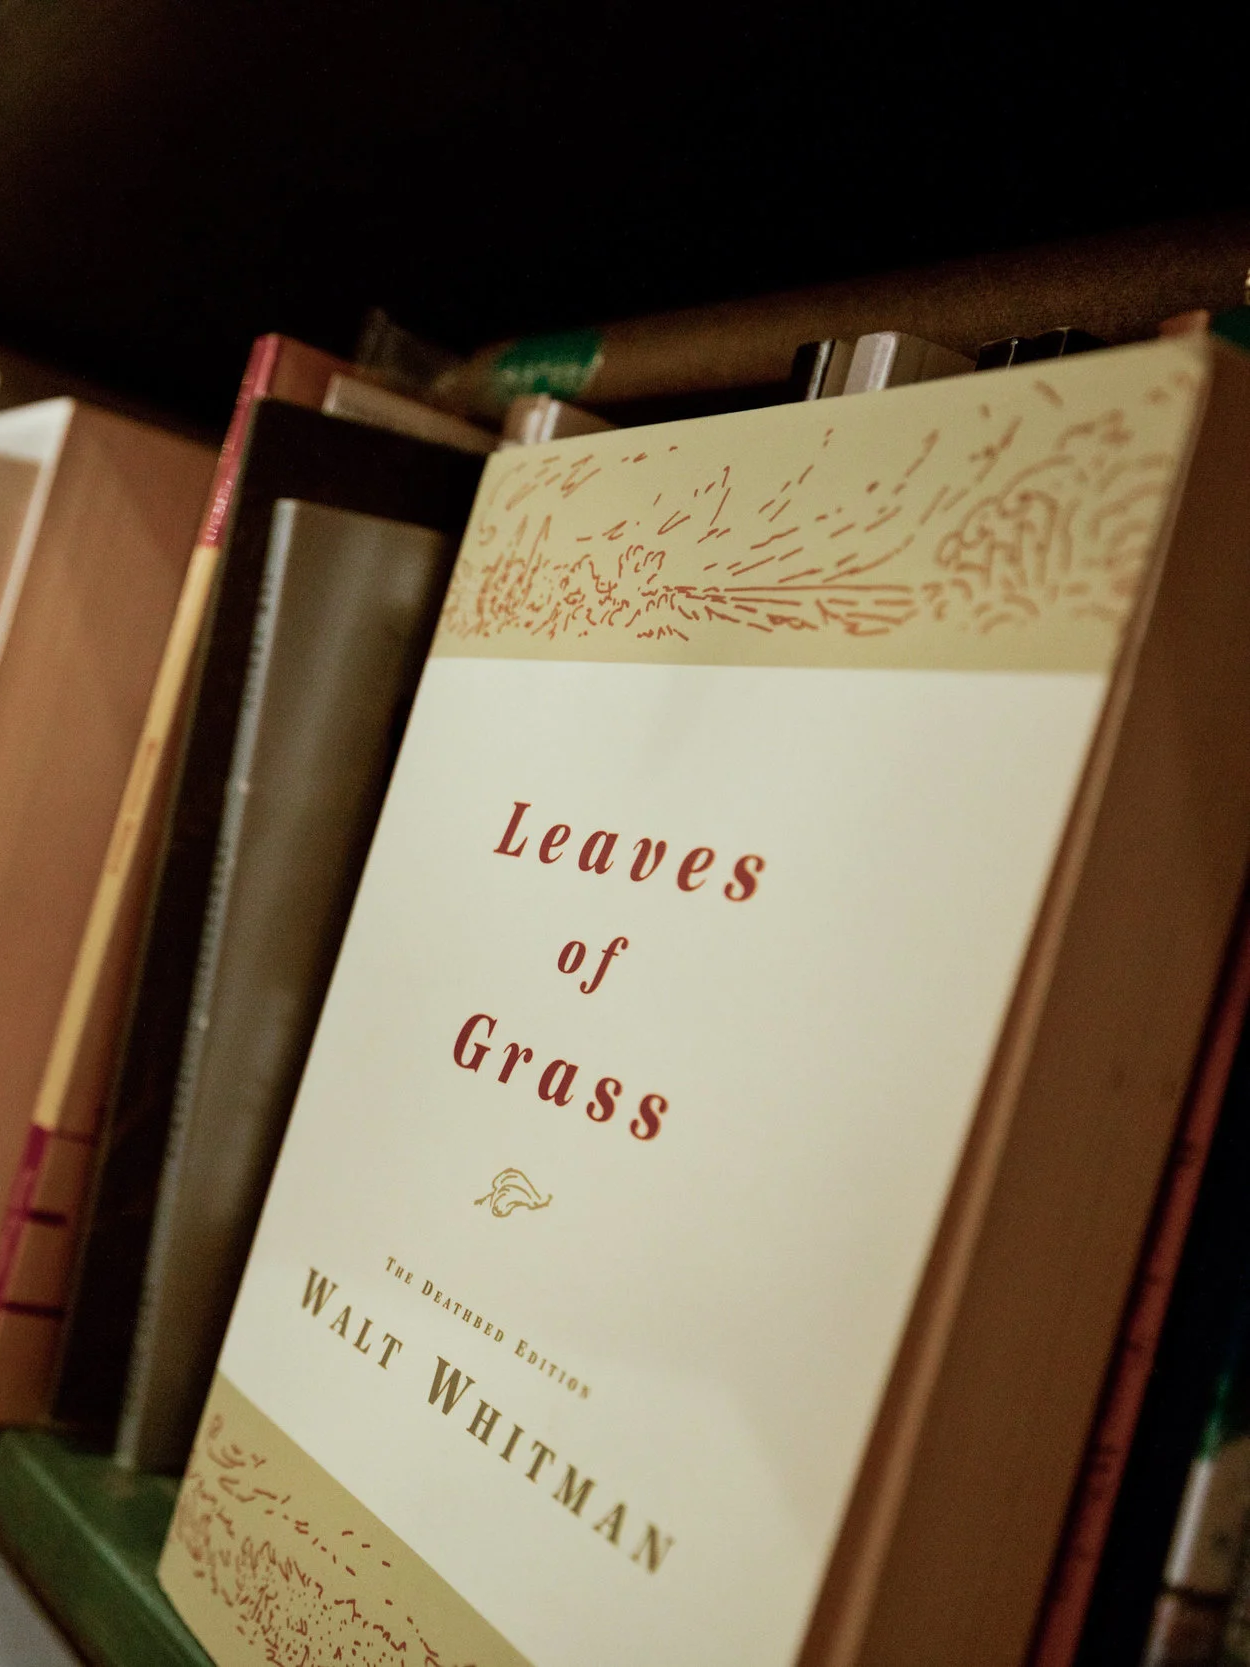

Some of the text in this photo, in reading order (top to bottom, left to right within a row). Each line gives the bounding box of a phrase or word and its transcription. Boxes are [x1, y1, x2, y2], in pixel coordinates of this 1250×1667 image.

[492, 800, 767, 903] Leaves
[557, 936, 630, 995] of
[452, 1013, 670, 1142] Grass
[299, 1267, 404, 1370] WALT
[427, 1355, 675, 1576] WHITMAN
